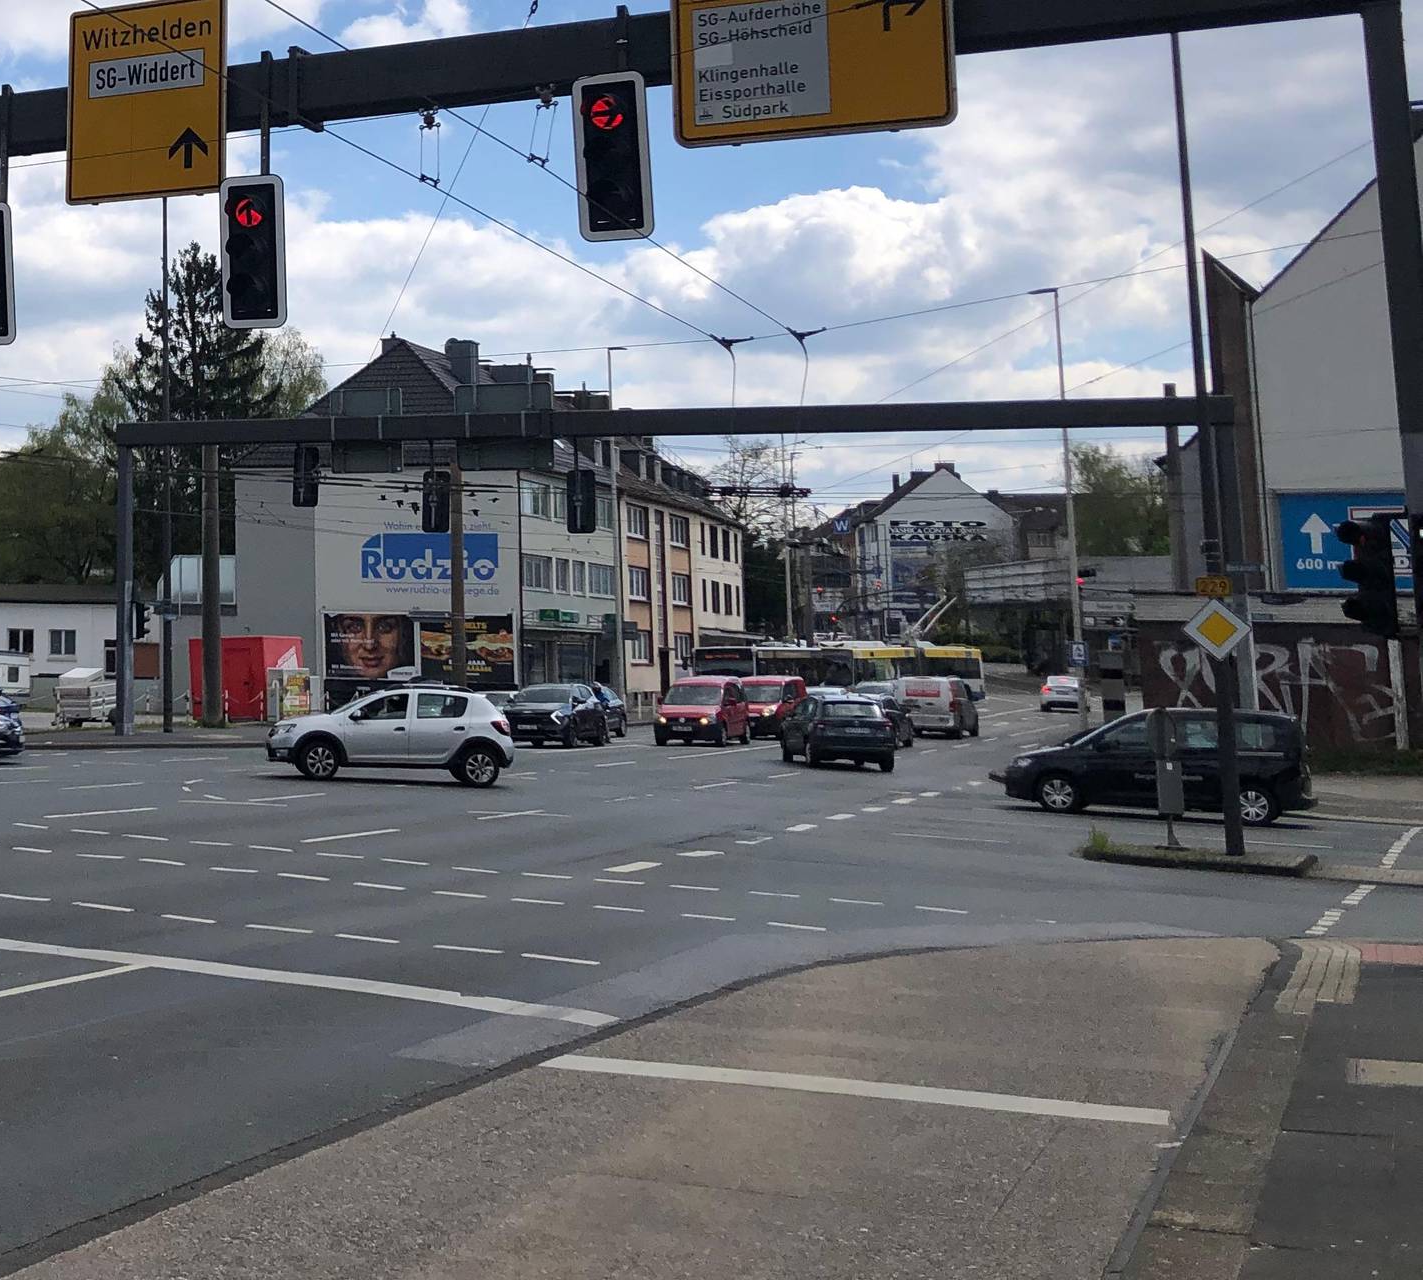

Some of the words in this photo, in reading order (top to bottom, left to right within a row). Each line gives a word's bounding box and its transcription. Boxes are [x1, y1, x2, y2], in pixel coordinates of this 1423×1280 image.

[698, 2, 821, 27] SG-Aufderhöhe
[82, 17, 212, 51] Witzhelden
[698, 20, 812, 46] SG-Höhscheid
[95, 60, 195, 90] SG-Widdert
[698, 62, 799, 83] Klingenhalle
[699, 80, 807, 102] Eissporthalle
[722, 101, 789, 119] Südpark
[361, 548, 496, 580] Rudzio
[1296, 558, 1323, 570] 600
[1200, 581, 1227, 593] 229
